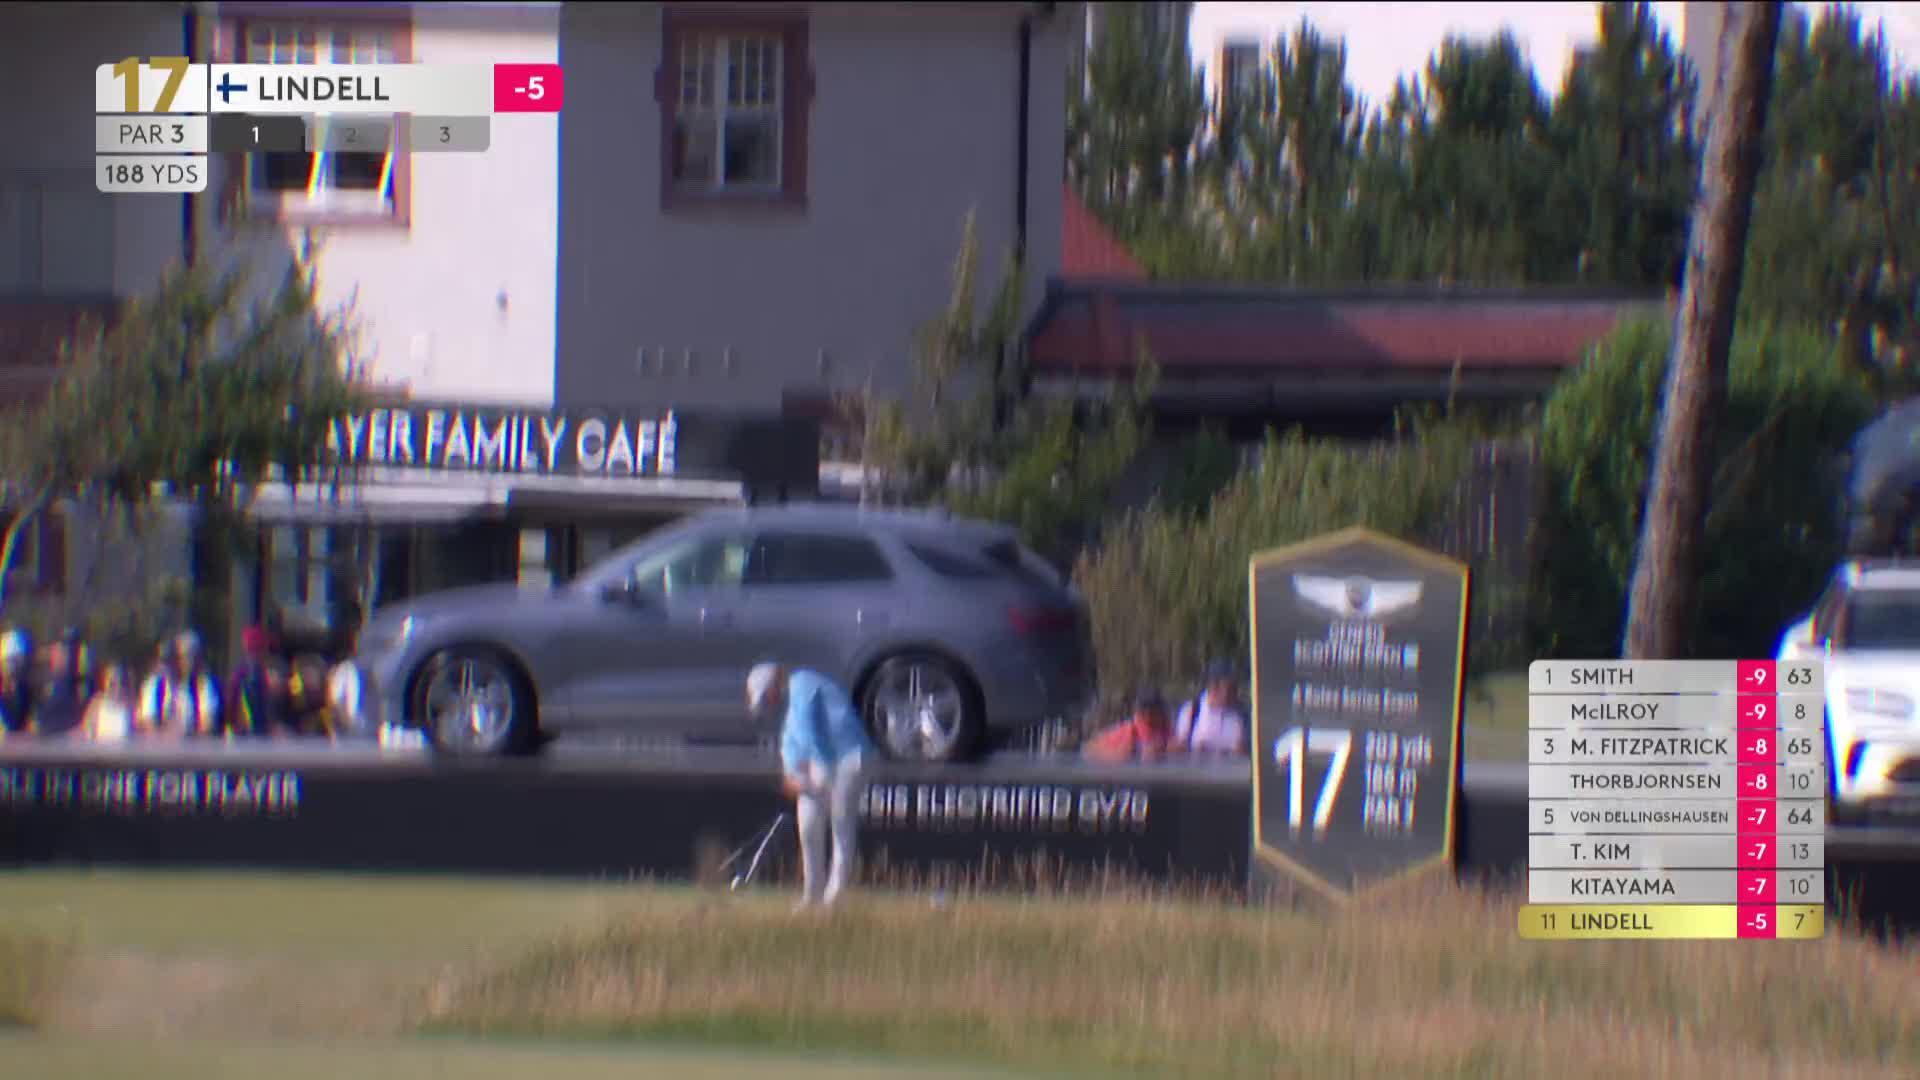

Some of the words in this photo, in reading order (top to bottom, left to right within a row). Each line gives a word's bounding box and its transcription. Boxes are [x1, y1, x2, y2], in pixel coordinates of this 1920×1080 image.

[325, 408, 413, 466] AYER
[425, 409, 567, 471] FAMILY
[577, 407, 677, 473] CAFÉ
[146, 769, 199, 806] FOR
[206, 770, 300, 808] PLAYER
[1274, 726, 1351, 833] 17
